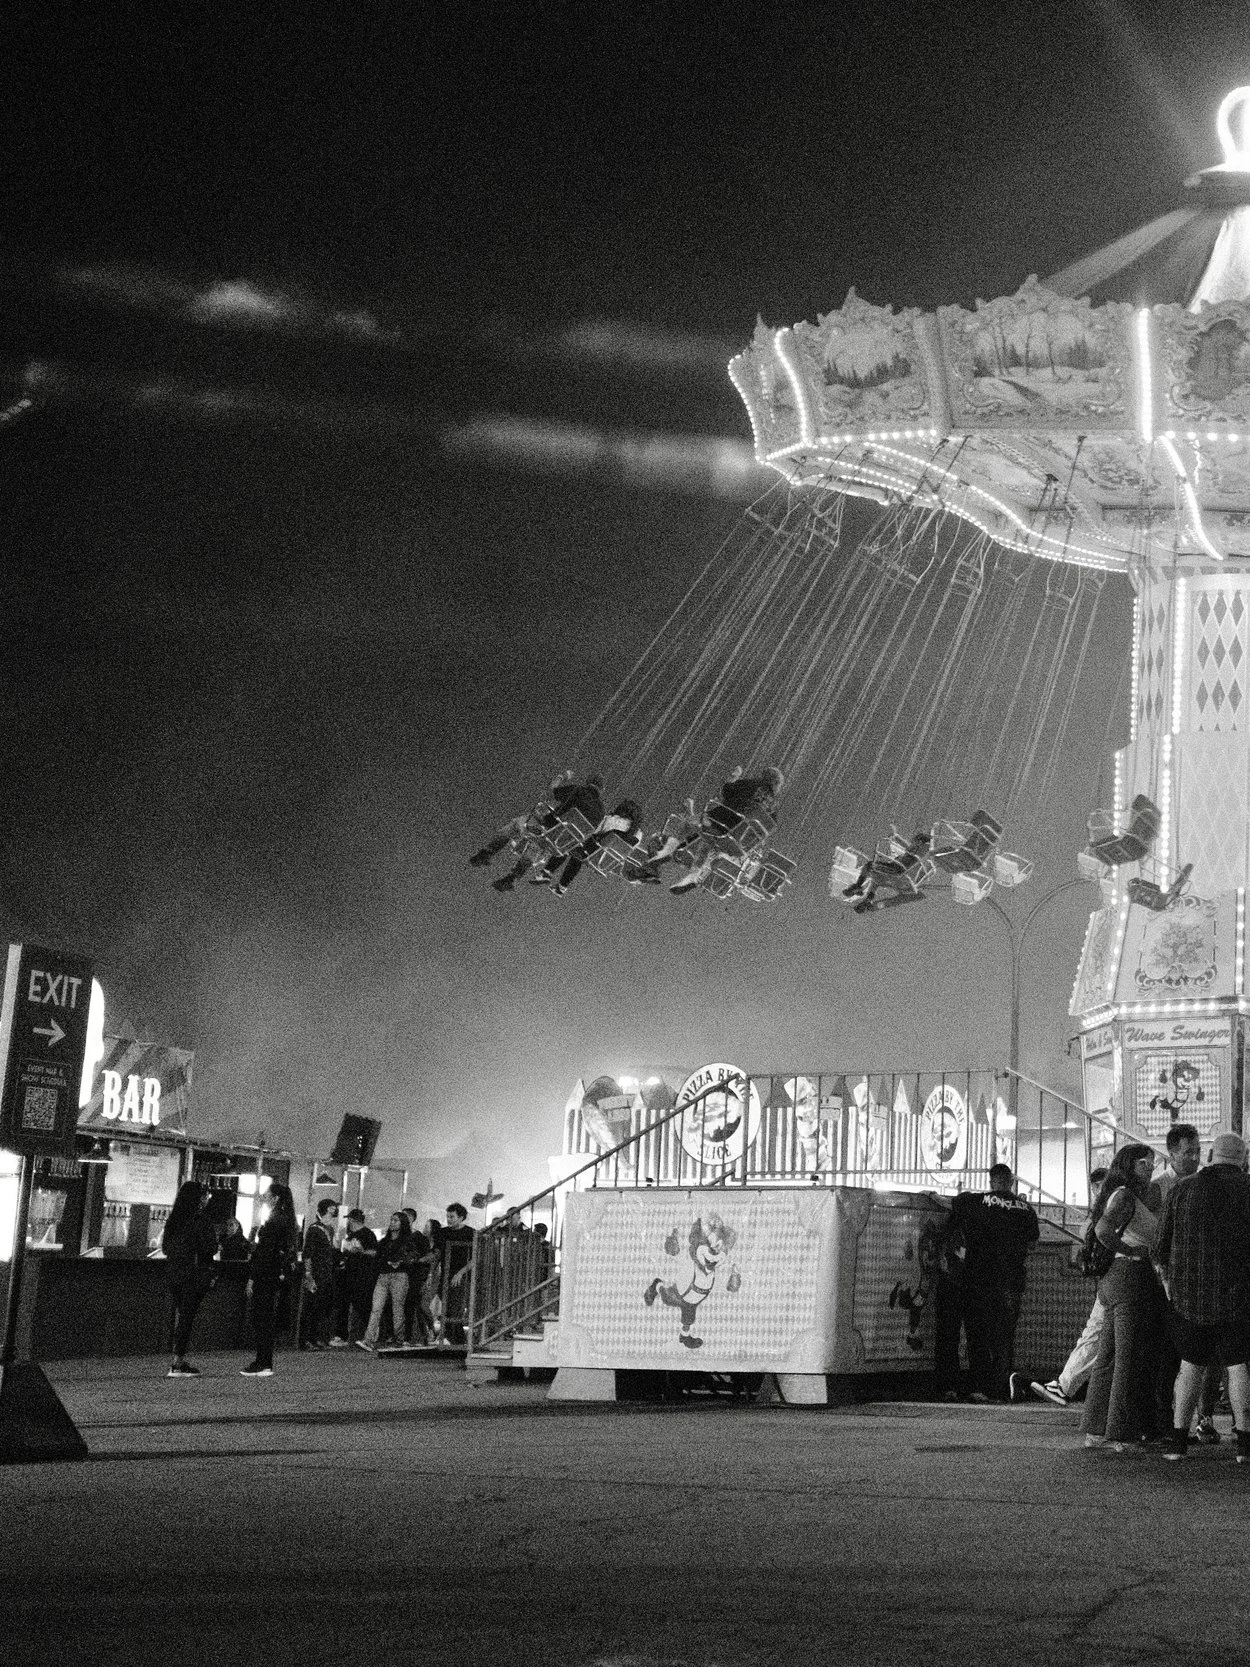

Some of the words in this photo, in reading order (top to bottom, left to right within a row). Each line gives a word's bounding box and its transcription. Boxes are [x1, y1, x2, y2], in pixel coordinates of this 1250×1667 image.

[28, 970, 82, 1008] EXIT
[1126, 1026, 1167, 1043] Wave
[1170, 1024, 1231, 1043] Swinger
[101, 1069, 162, 1126] BAR
[682, 1069, 714, 1102] PIZZA
